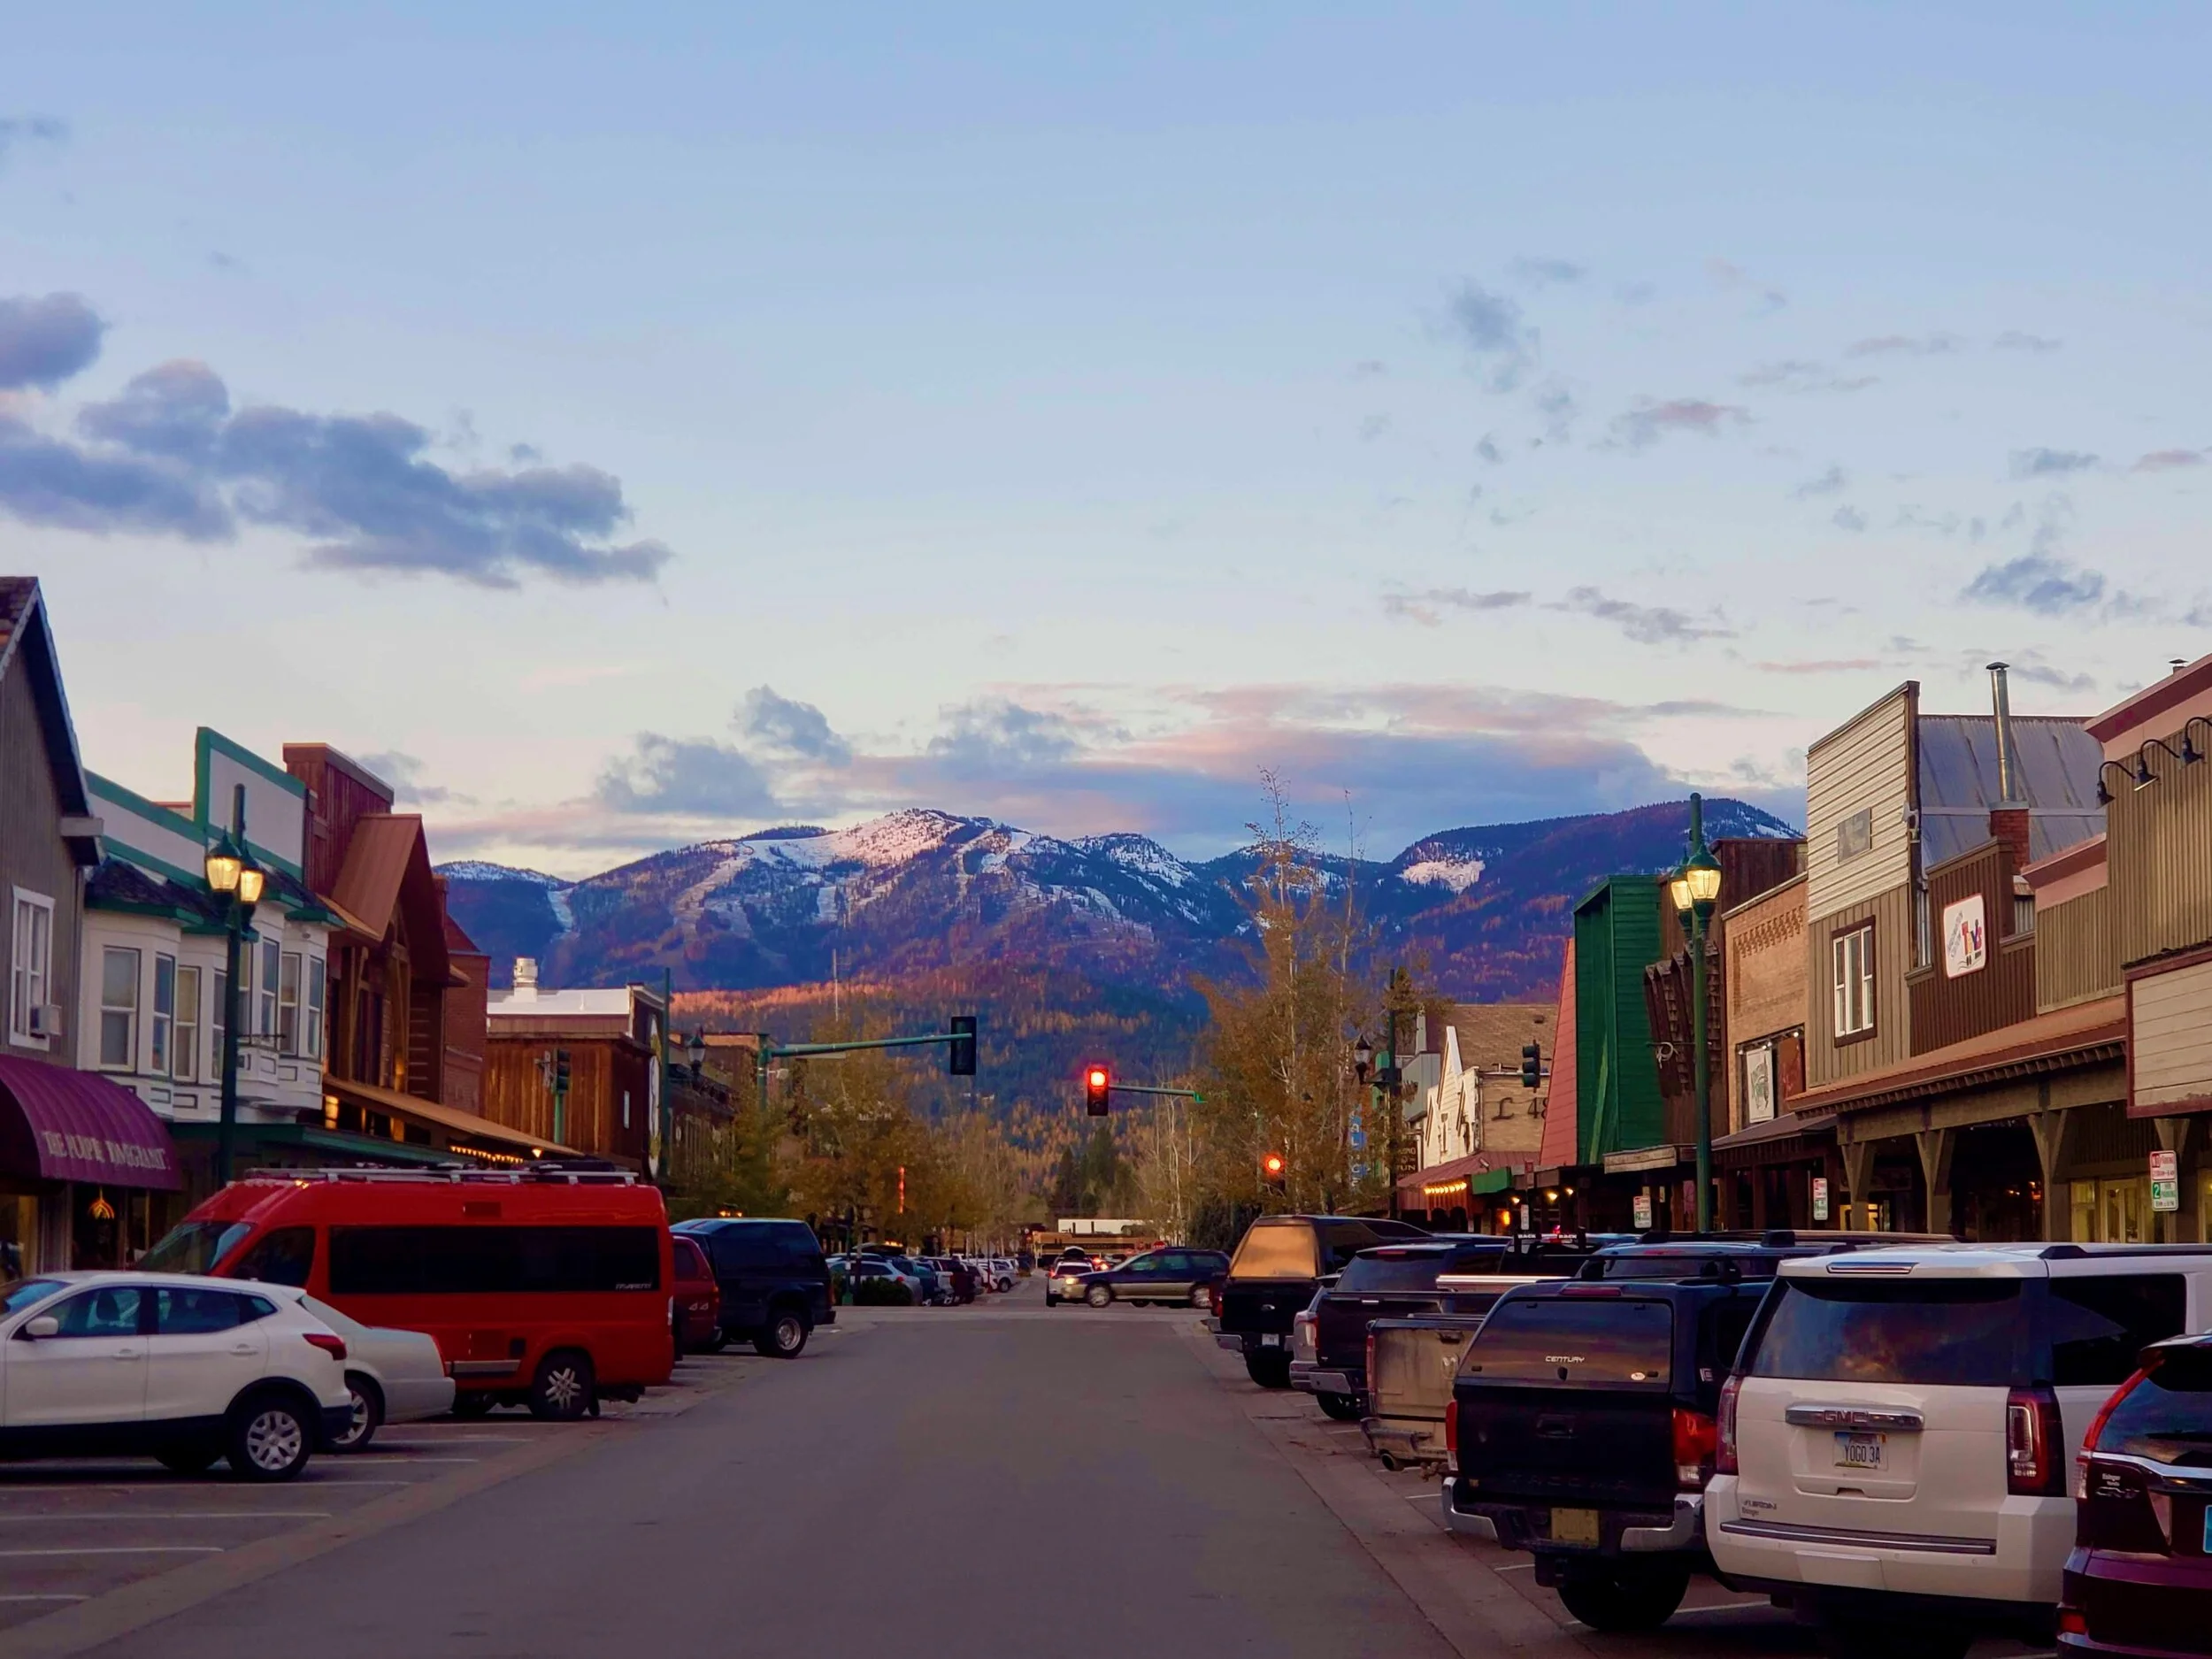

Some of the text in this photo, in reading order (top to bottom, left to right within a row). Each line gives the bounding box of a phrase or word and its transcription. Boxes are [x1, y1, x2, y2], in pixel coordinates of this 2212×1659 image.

[1824, 1410, 1868, 1424] GMC
[1845, 1444, 1881, 1464] YOGO 3A
